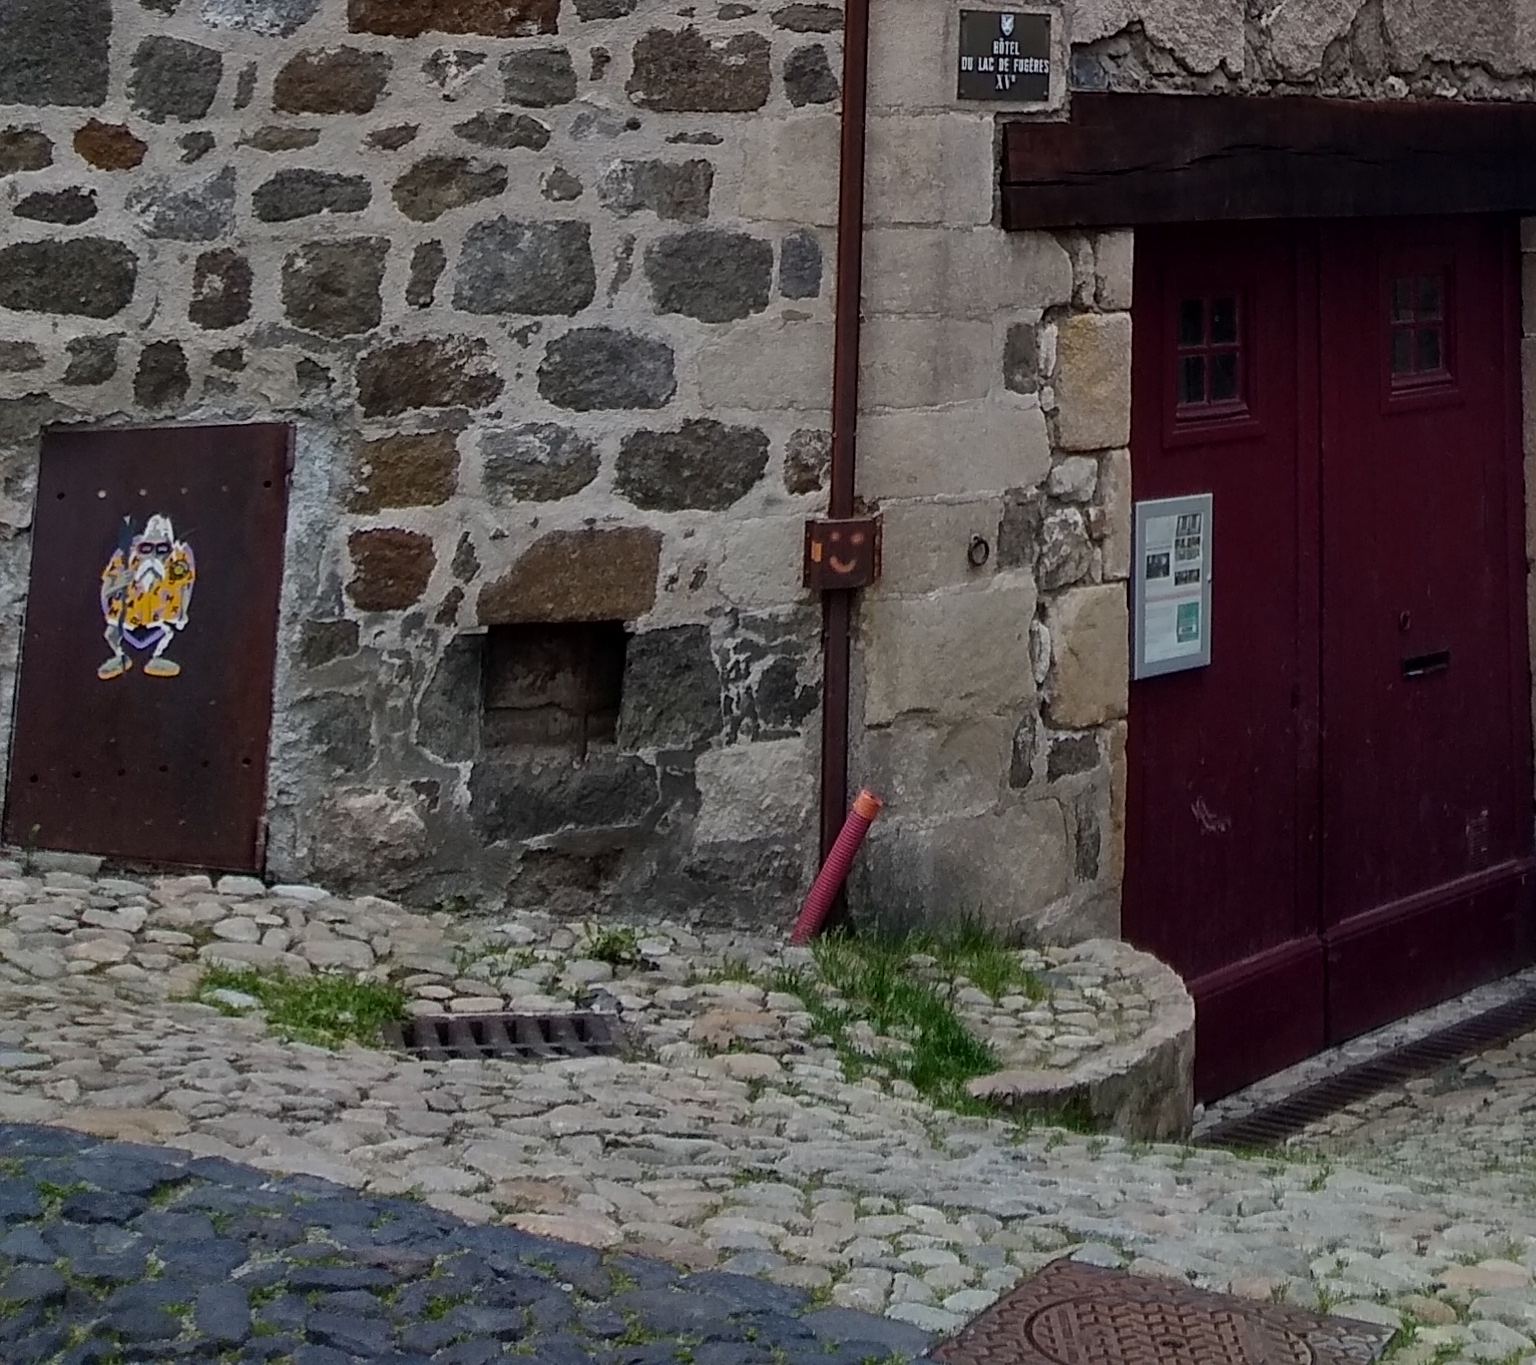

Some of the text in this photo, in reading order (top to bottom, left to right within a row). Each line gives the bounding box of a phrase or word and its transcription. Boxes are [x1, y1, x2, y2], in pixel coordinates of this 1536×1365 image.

[993, 37, 1020, 55] HÔTEL
[961, 56, 974, 70] DU
[978, 57, 995, 71] LAC
[998, 57, 1010, 72] DE
